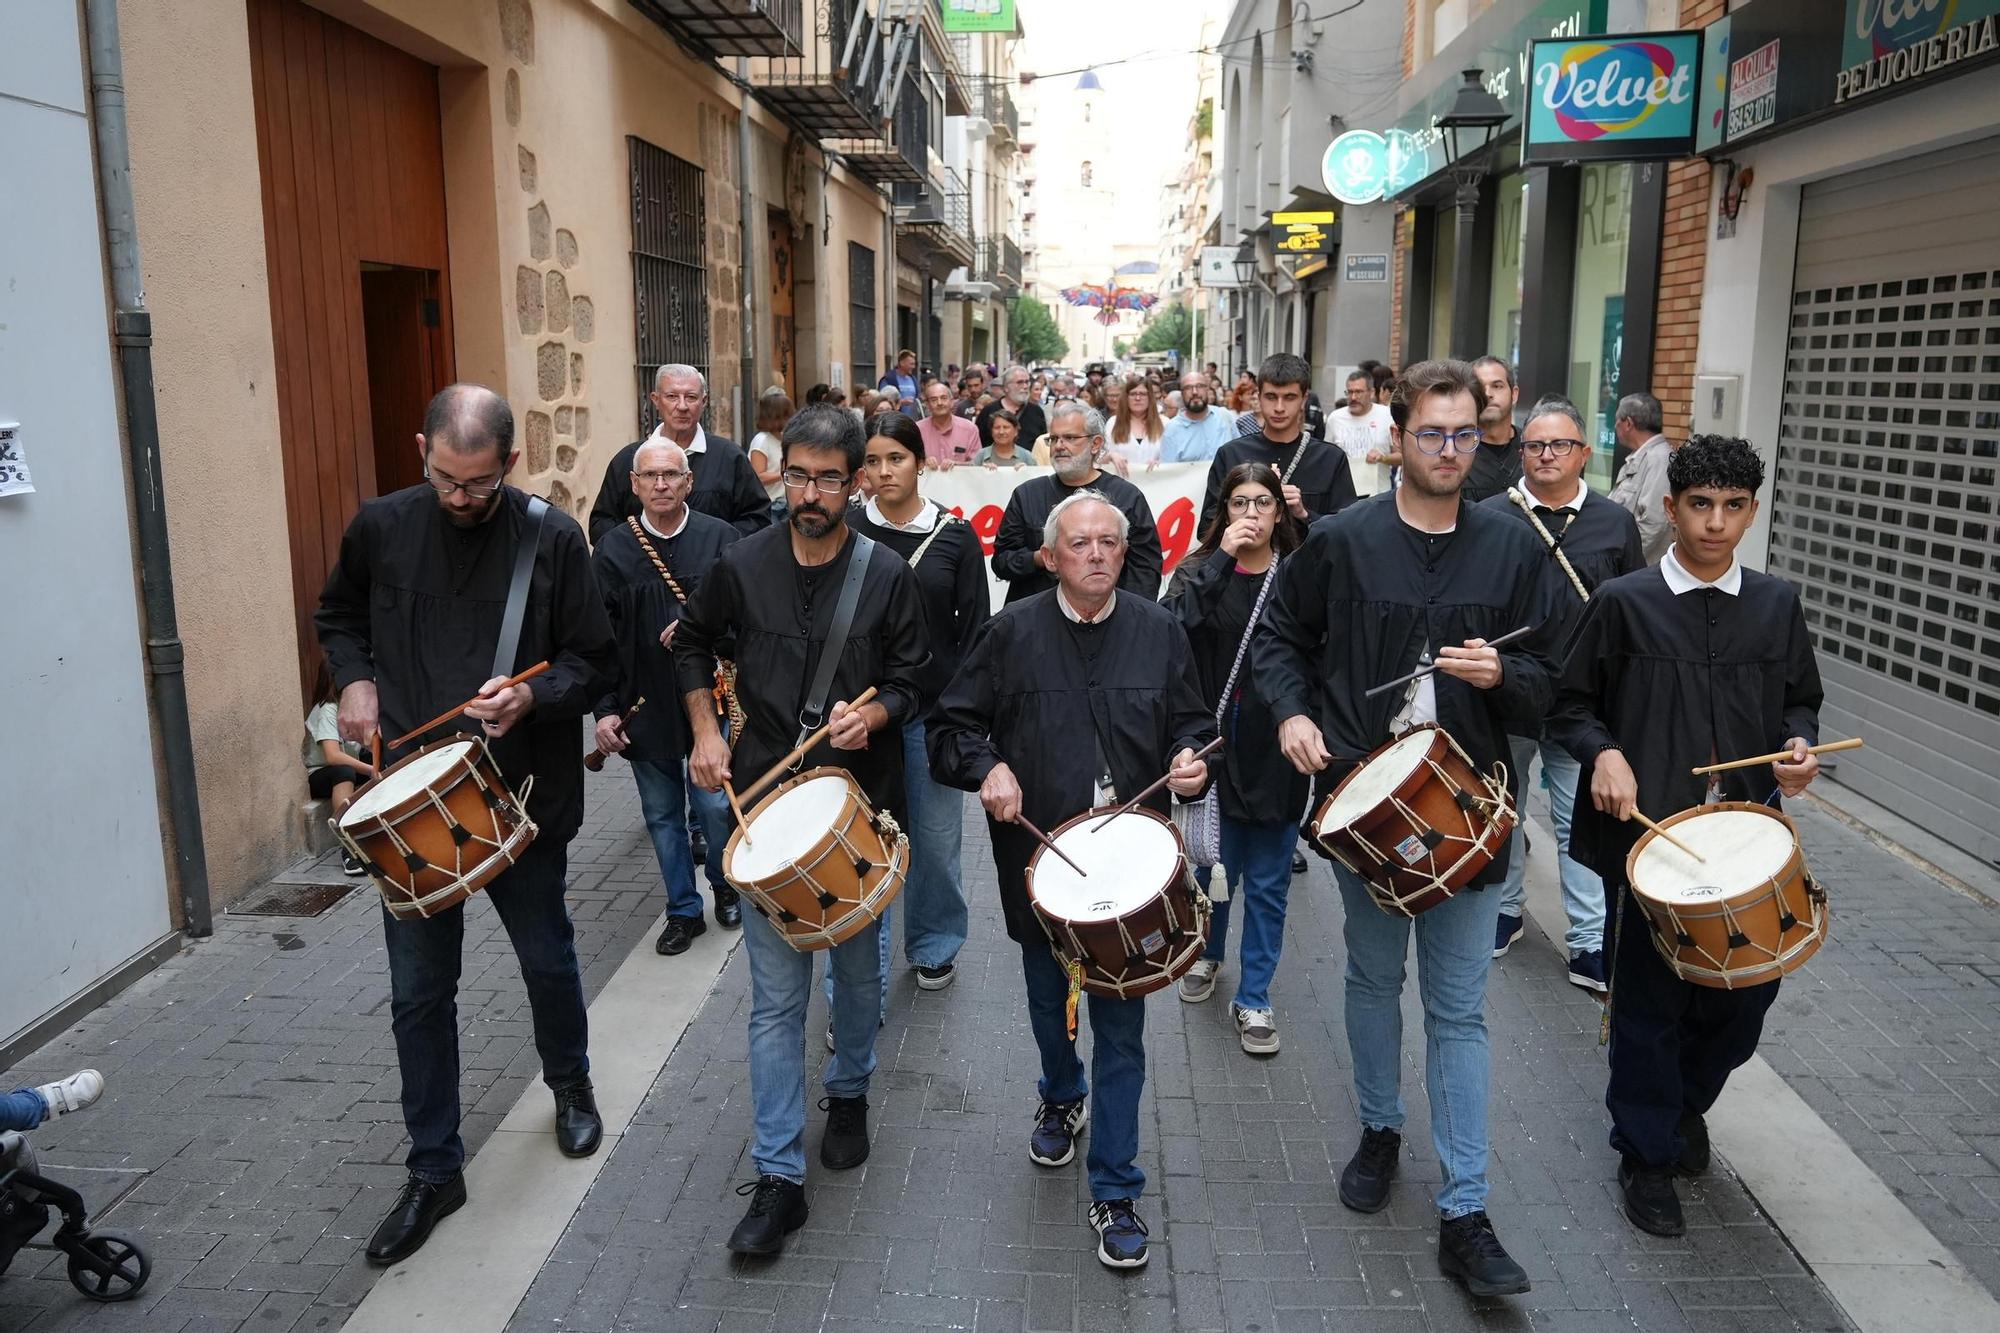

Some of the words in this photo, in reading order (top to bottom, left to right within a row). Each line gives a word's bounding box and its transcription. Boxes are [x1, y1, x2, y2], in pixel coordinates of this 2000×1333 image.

[1535, 59, 1690, 109] Velvet
[1732, 44, 1776, 90] ALQUILA
[1834, 14, 2000, 104] PELUQUERIA
